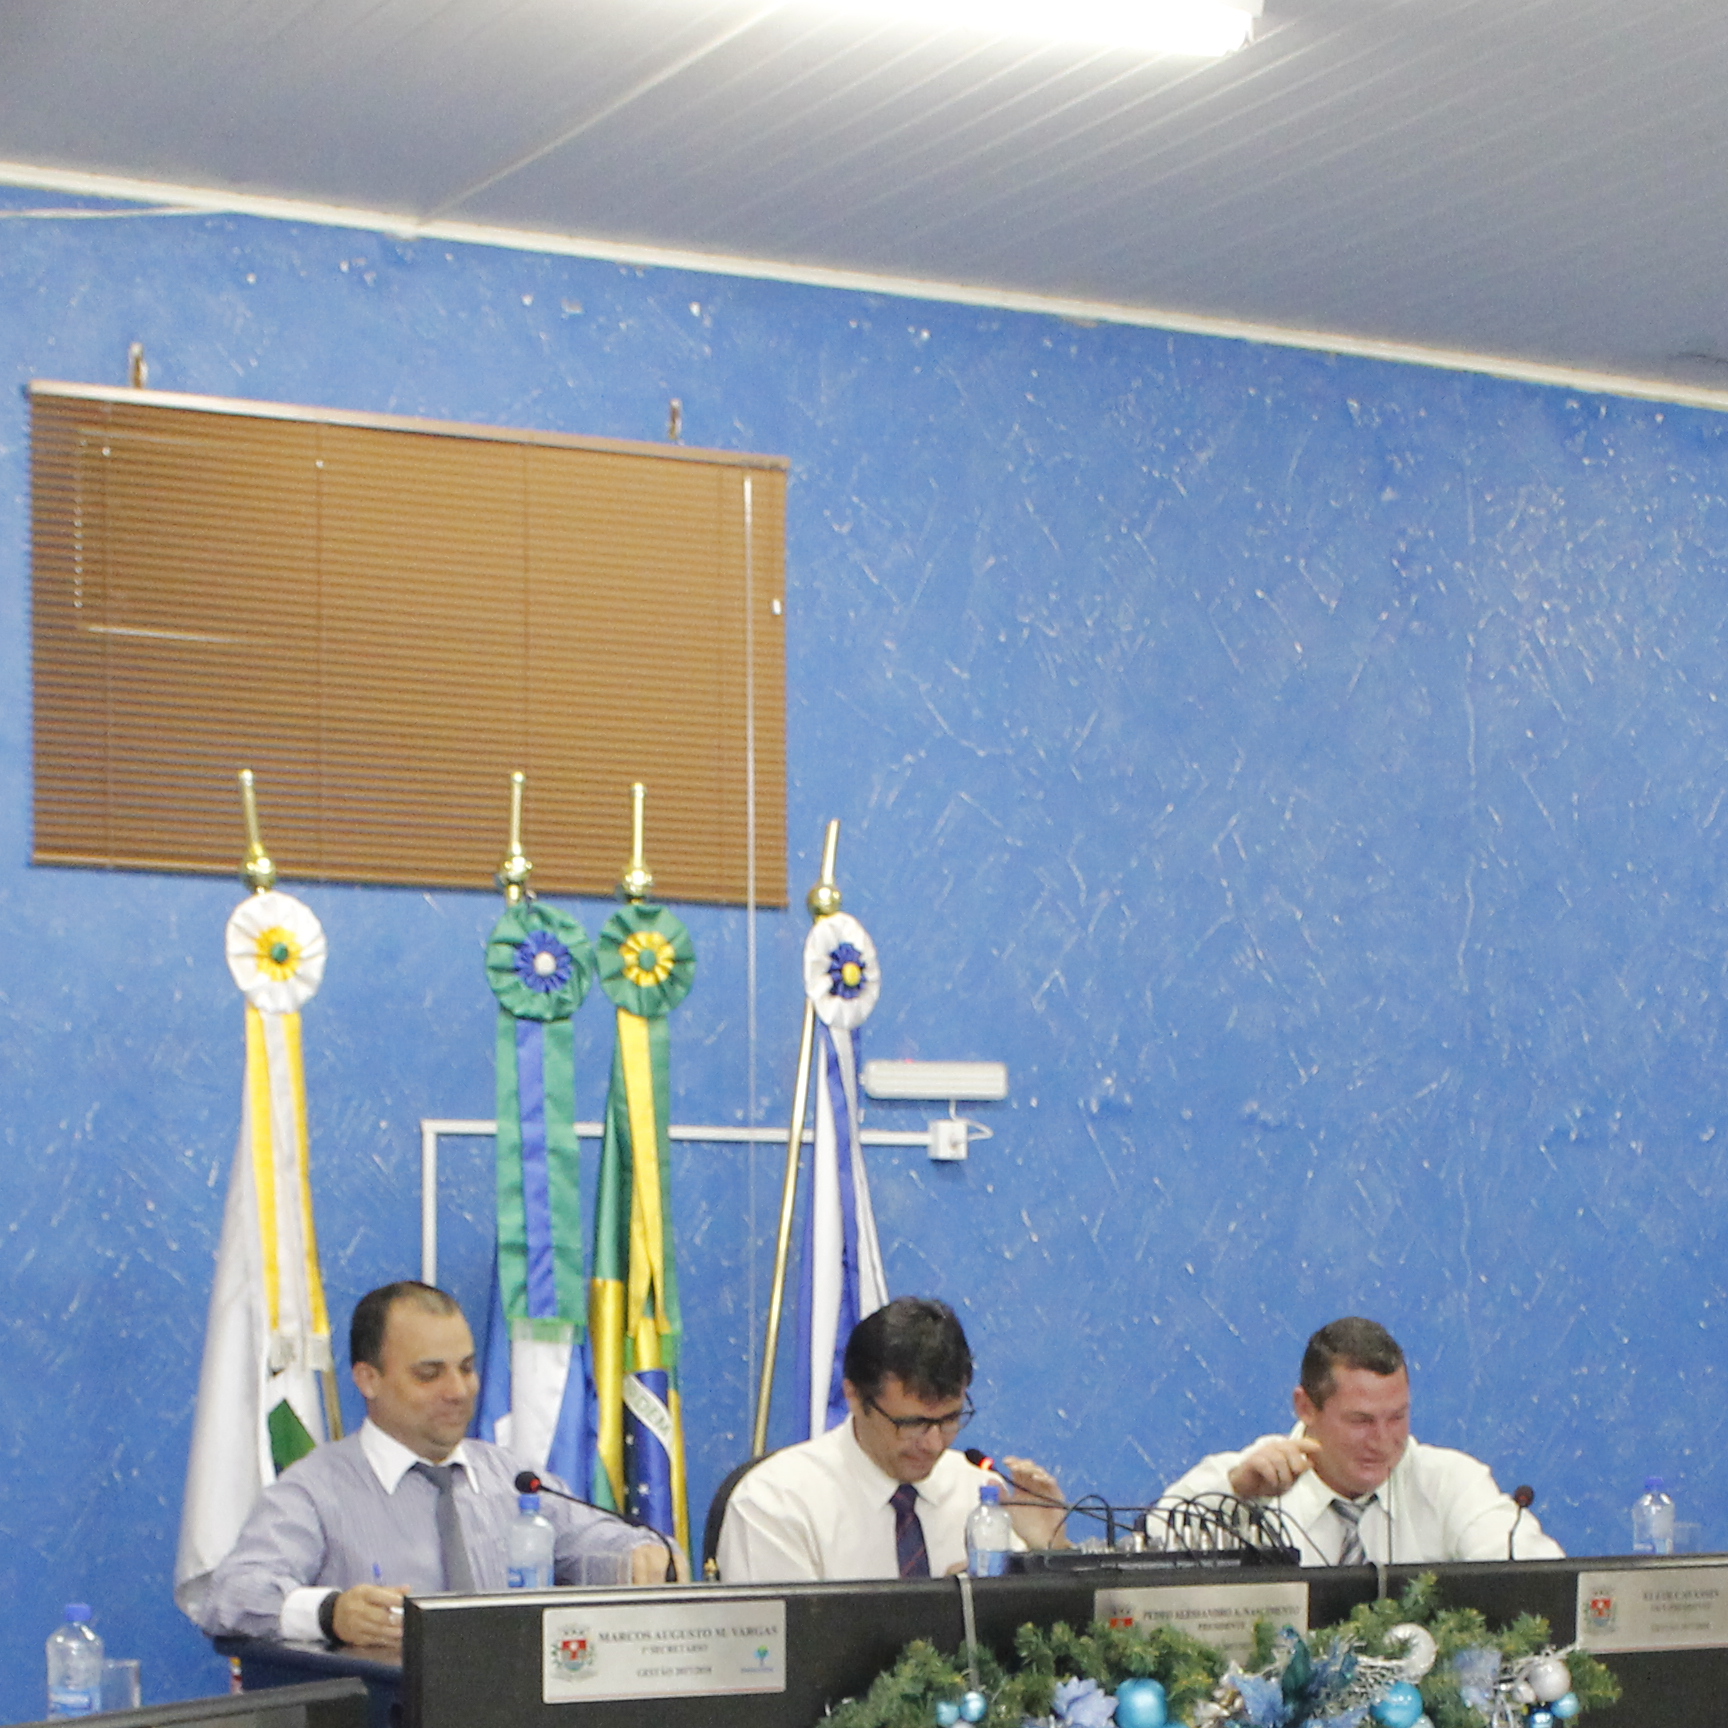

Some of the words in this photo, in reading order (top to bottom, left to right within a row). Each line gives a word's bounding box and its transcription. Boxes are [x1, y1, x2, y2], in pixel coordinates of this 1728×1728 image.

[598, 1630, 652, 1643] MARCOS
[655, 1628, 712, 1641] AUGUSTO
[730, 1625, 778, 1638] VARGAS
